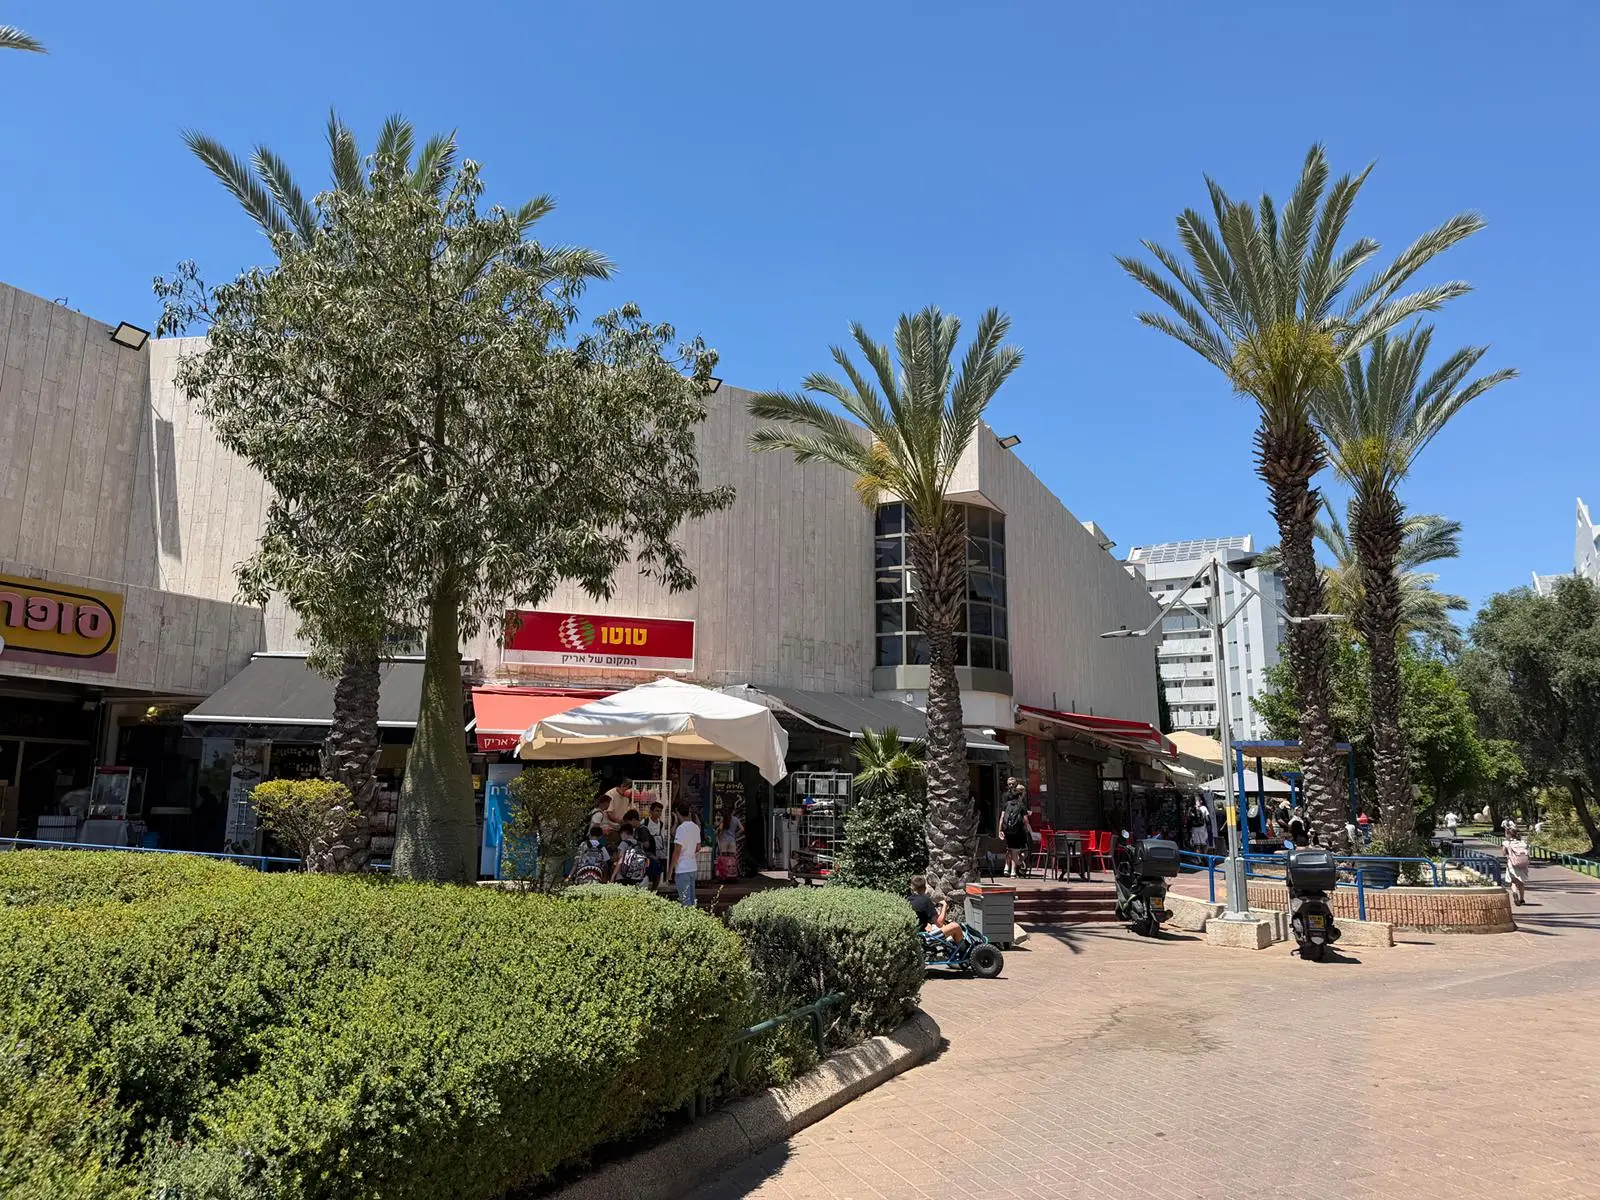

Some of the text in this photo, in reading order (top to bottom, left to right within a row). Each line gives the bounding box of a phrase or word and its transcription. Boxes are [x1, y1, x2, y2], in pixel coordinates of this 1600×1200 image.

[601, 626, 648, 646] טוטו
[562, 654, 637, 666] המקום של אריק
[483, 738, 508, 748] אריק
